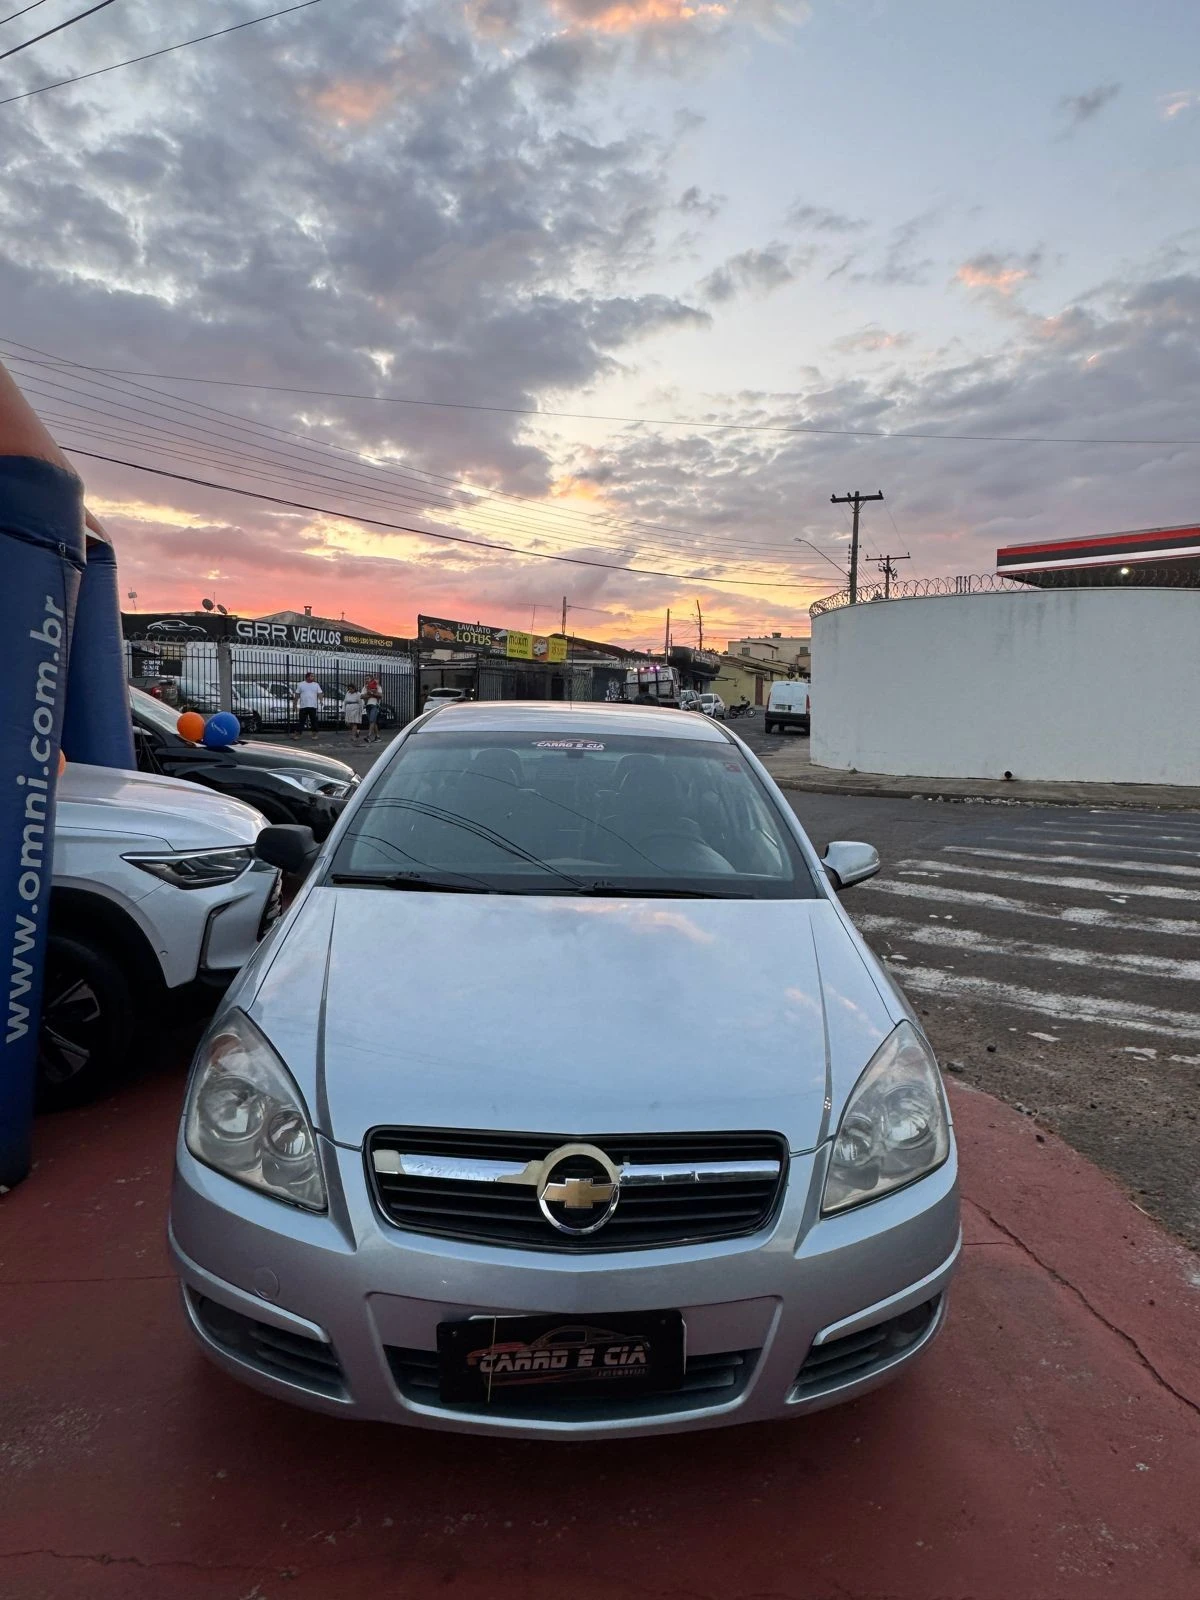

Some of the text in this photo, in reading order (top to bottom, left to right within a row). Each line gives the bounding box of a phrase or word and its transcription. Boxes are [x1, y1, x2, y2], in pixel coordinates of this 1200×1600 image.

[236, 621, 288, 640] GRR
[292, 626, 341, 646] VEÍCULOS
[456, 630, 492, 646] LOTUS
[6, 595, 65, 1044] www.omni.com.br
[480, 1349, 569, 1373] CARRO
[577, 1347, 595, 1368] E
